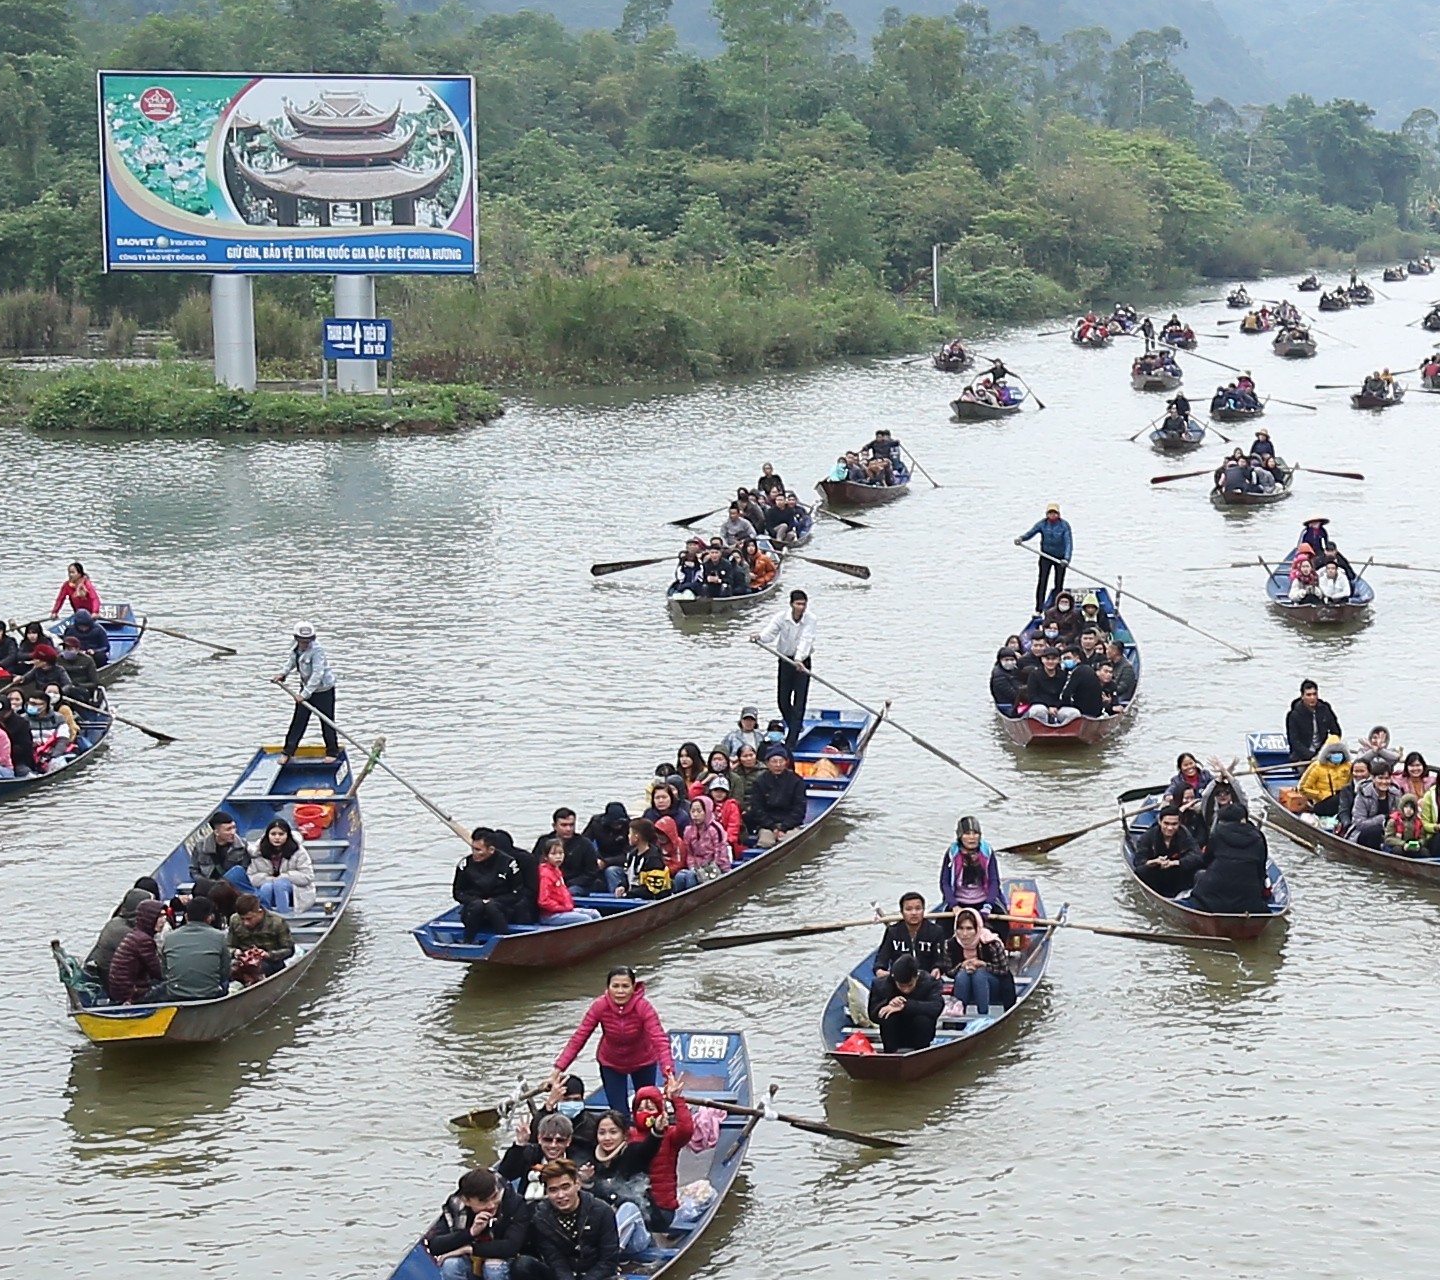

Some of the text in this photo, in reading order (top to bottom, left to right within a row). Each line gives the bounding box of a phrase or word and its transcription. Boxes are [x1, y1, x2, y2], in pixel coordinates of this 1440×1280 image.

[263, 242, 280, 259] BẢO
[282, 245, 293, 262] VỆ
[295, 247, 304, 259] DI
[326, 243, 350, 260] QUỐC
[351, 247, 367, 260] GIA
[690, 1046, 724, 1058] 3151
